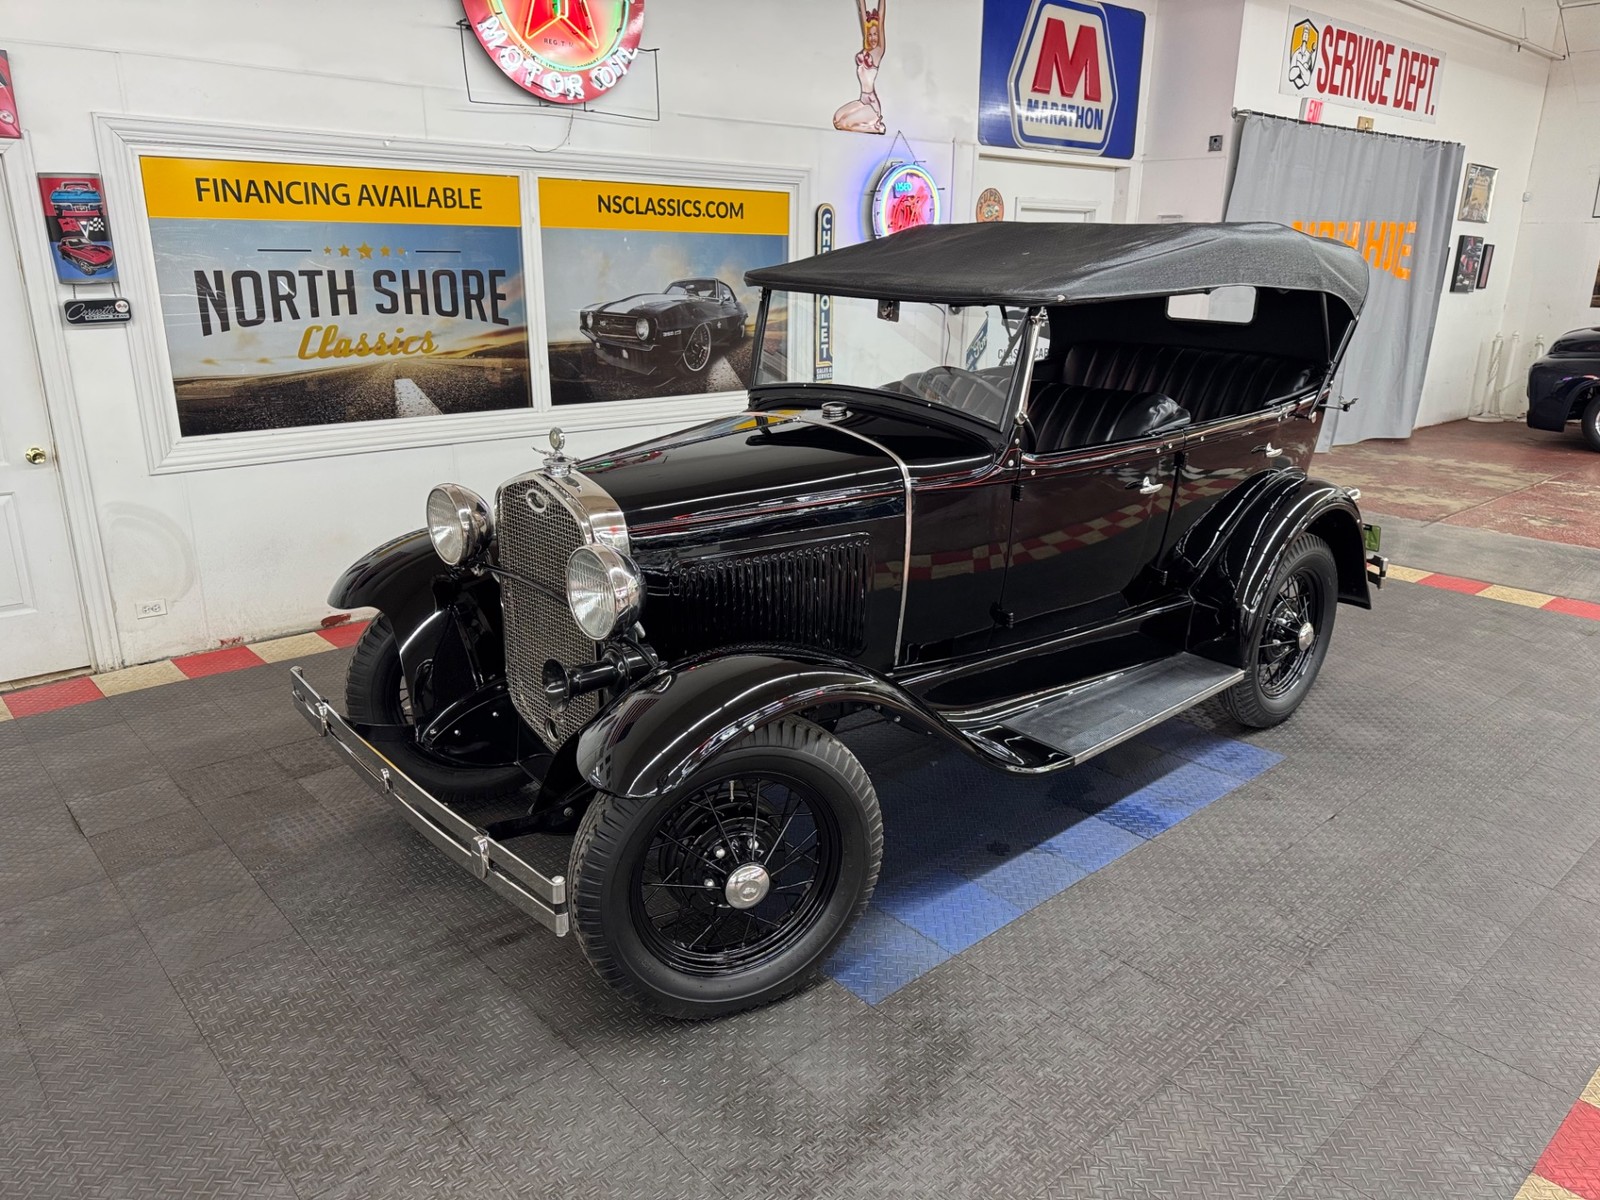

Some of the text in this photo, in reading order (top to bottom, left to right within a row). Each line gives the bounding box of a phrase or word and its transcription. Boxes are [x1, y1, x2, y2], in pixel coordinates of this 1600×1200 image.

[477, 15, 639, 100] MOTOR OIL
[1316, 24, 1440, 116] SERVICE DEPT.
[1025, 98, 1104, 130] MARATHON
[1307, 100, 1323, 121] EXIT
[195, 177, 483, 209] FINANCING AVAILABLE
[597, 194, 745, 220] NSCLASSICS.COM
[193, 269, 509, 337] NORTH SHORE
[820, 213, 832, 358] CHOLET
[297, 324, 440, 360] Classics
